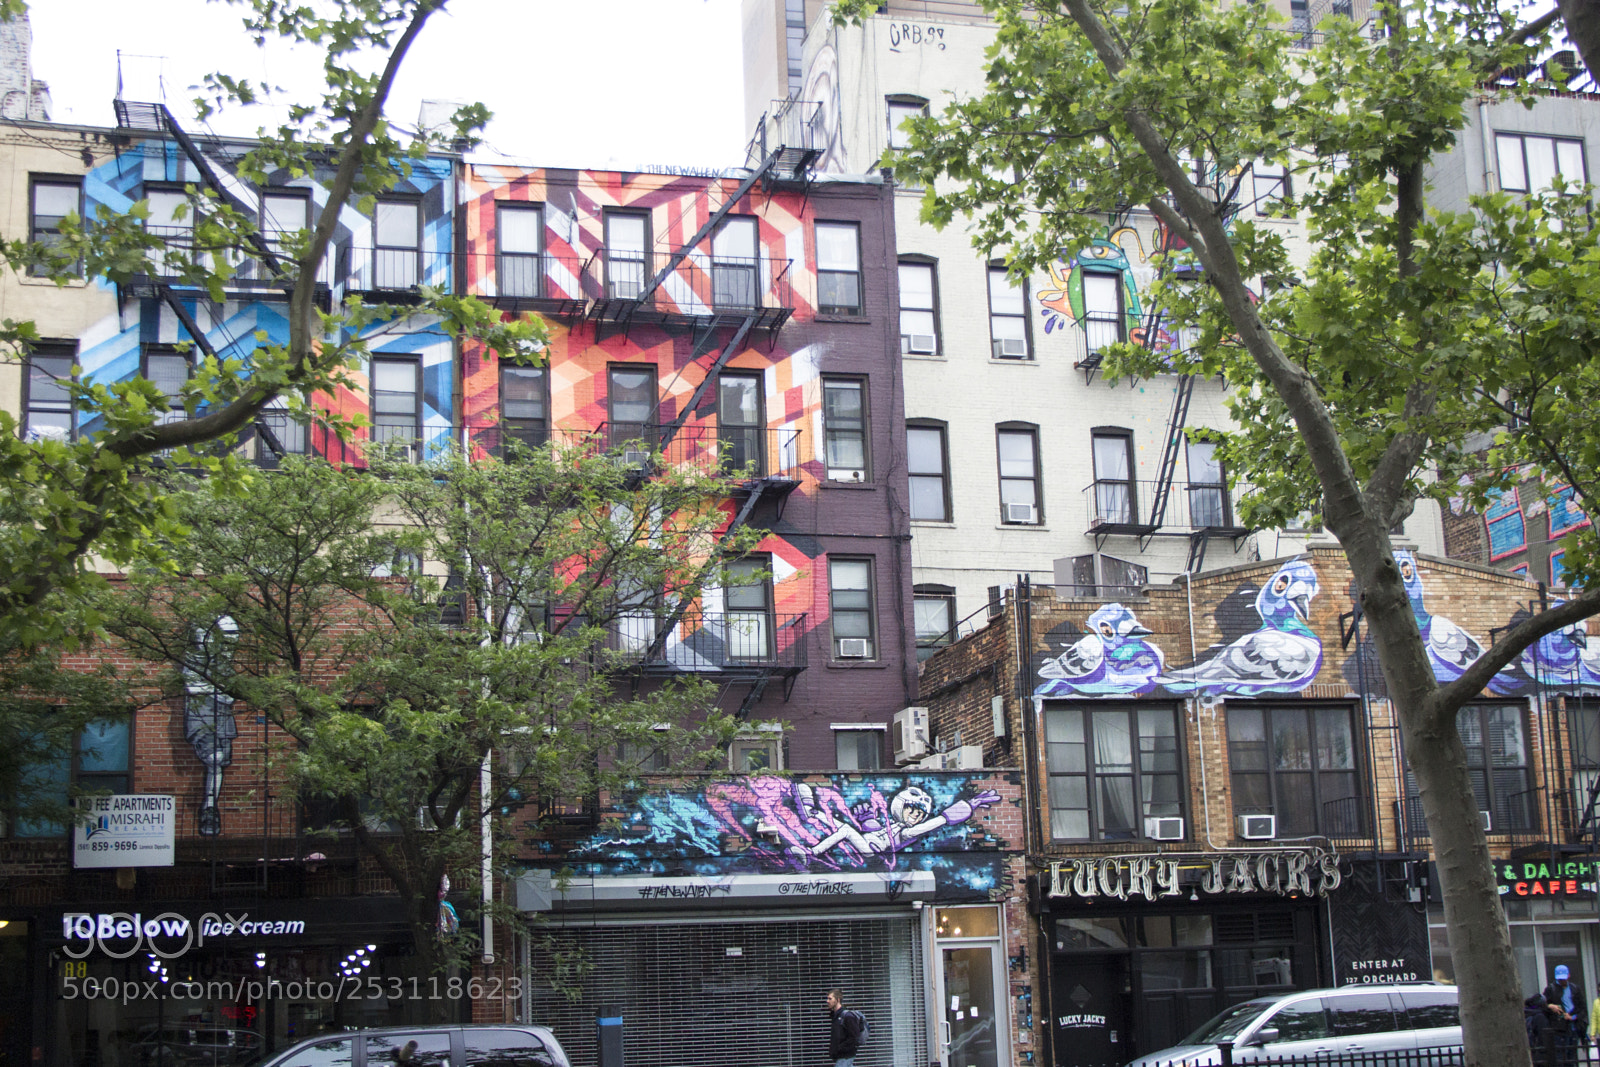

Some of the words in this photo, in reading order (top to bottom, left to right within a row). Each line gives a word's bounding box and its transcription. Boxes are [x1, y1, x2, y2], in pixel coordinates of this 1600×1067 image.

[96, 798, 110, 811] FEE
[113, 797, 172, 811] APARTMENTS
[110, 813, 165, 825] MISRAHI
[1503, 864, 1518, 879] &
[1048, 857, 1183, 902] LUCKY
[1515, 880, 1578, 896] CAFE
[202, 919, 235, 936] ice
[241, 919, 306, 935] cream
[1352, 960, 1388, 970] ENTER
[1391, 958, 1404, 968] AT
[1345, 976, 1358, 984] 127
[1362, 972, 1417, 984] ORCHARD
[1059, 1015, 1081, 1026] LUCKY
[1083, 1014, 1106, 1024] JACK'S
